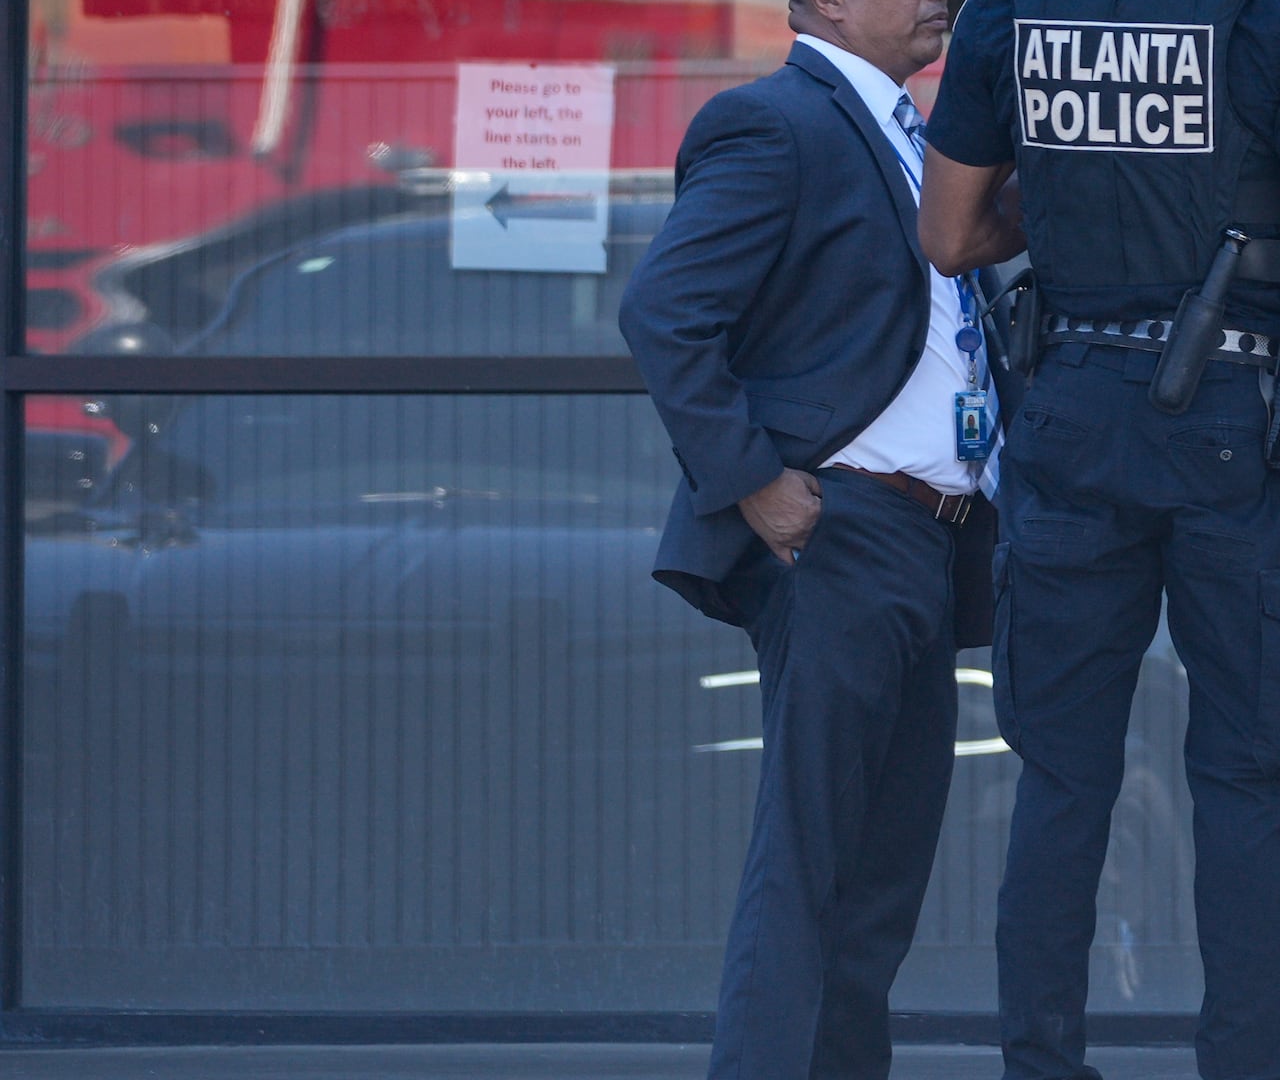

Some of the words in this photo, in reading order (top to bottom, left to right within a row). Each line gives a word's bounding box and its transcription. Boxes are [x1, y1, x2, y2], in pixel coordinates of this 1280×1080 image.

[1022, 28, 1204, 85] ATLANTA
[490, 79, 538, 94] Please
[542, 83, 561, 98] go
[565, 81, 581, 94] to
[485, 107, 519, 121] your
[523, 106, 553, 121] left,
[558, 106, 583, 120] the
[1023, 88, 1205, 145] POLICE
[485, 130, 512, 144] line
[515, 132, 558, 146] starts
[562, 135, 582, 147] on
[503, 156, 527, 170] the
[531, 156, 560, 171] left.
